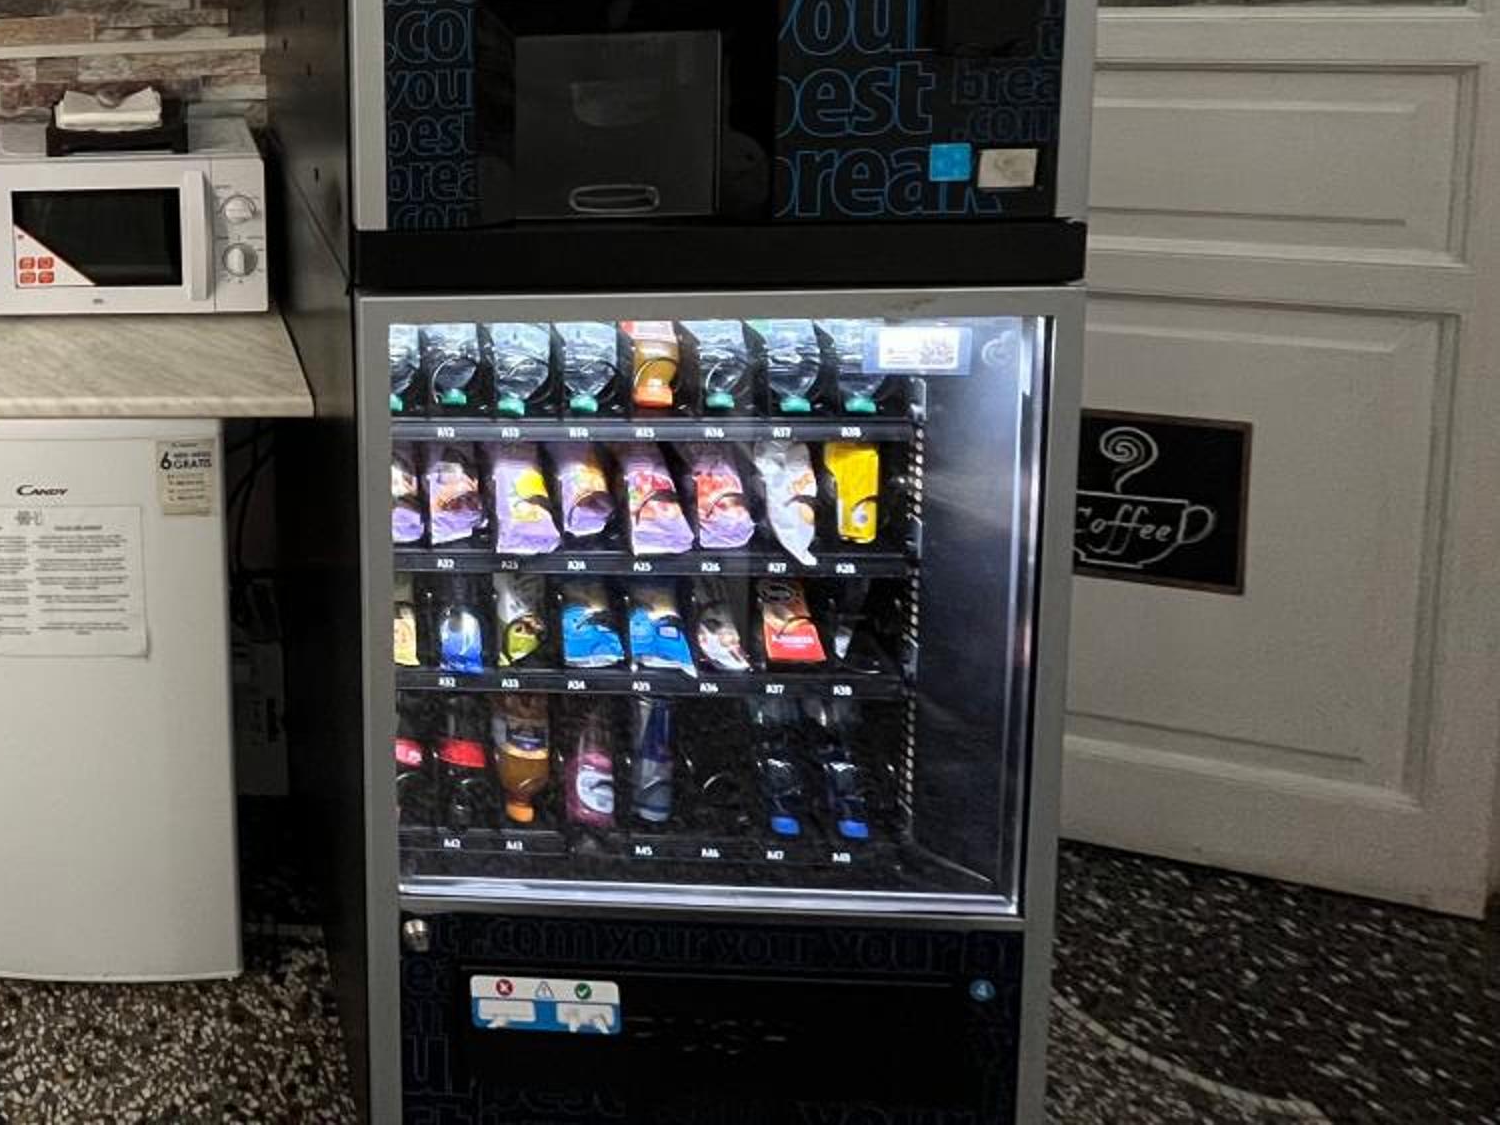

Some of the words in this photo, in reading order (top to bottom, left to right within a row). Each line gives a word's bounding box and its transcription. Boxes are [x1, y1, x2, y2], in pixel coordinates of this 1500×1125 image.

[436, 426, 455, 438] A12
[772, 426, 792, 438] A17
[160, 451, 172, 470] 6
[567, 560, 586, 571] A24
[567, 680, 586, 690] A34
[765, 684, 785, 694] A37
